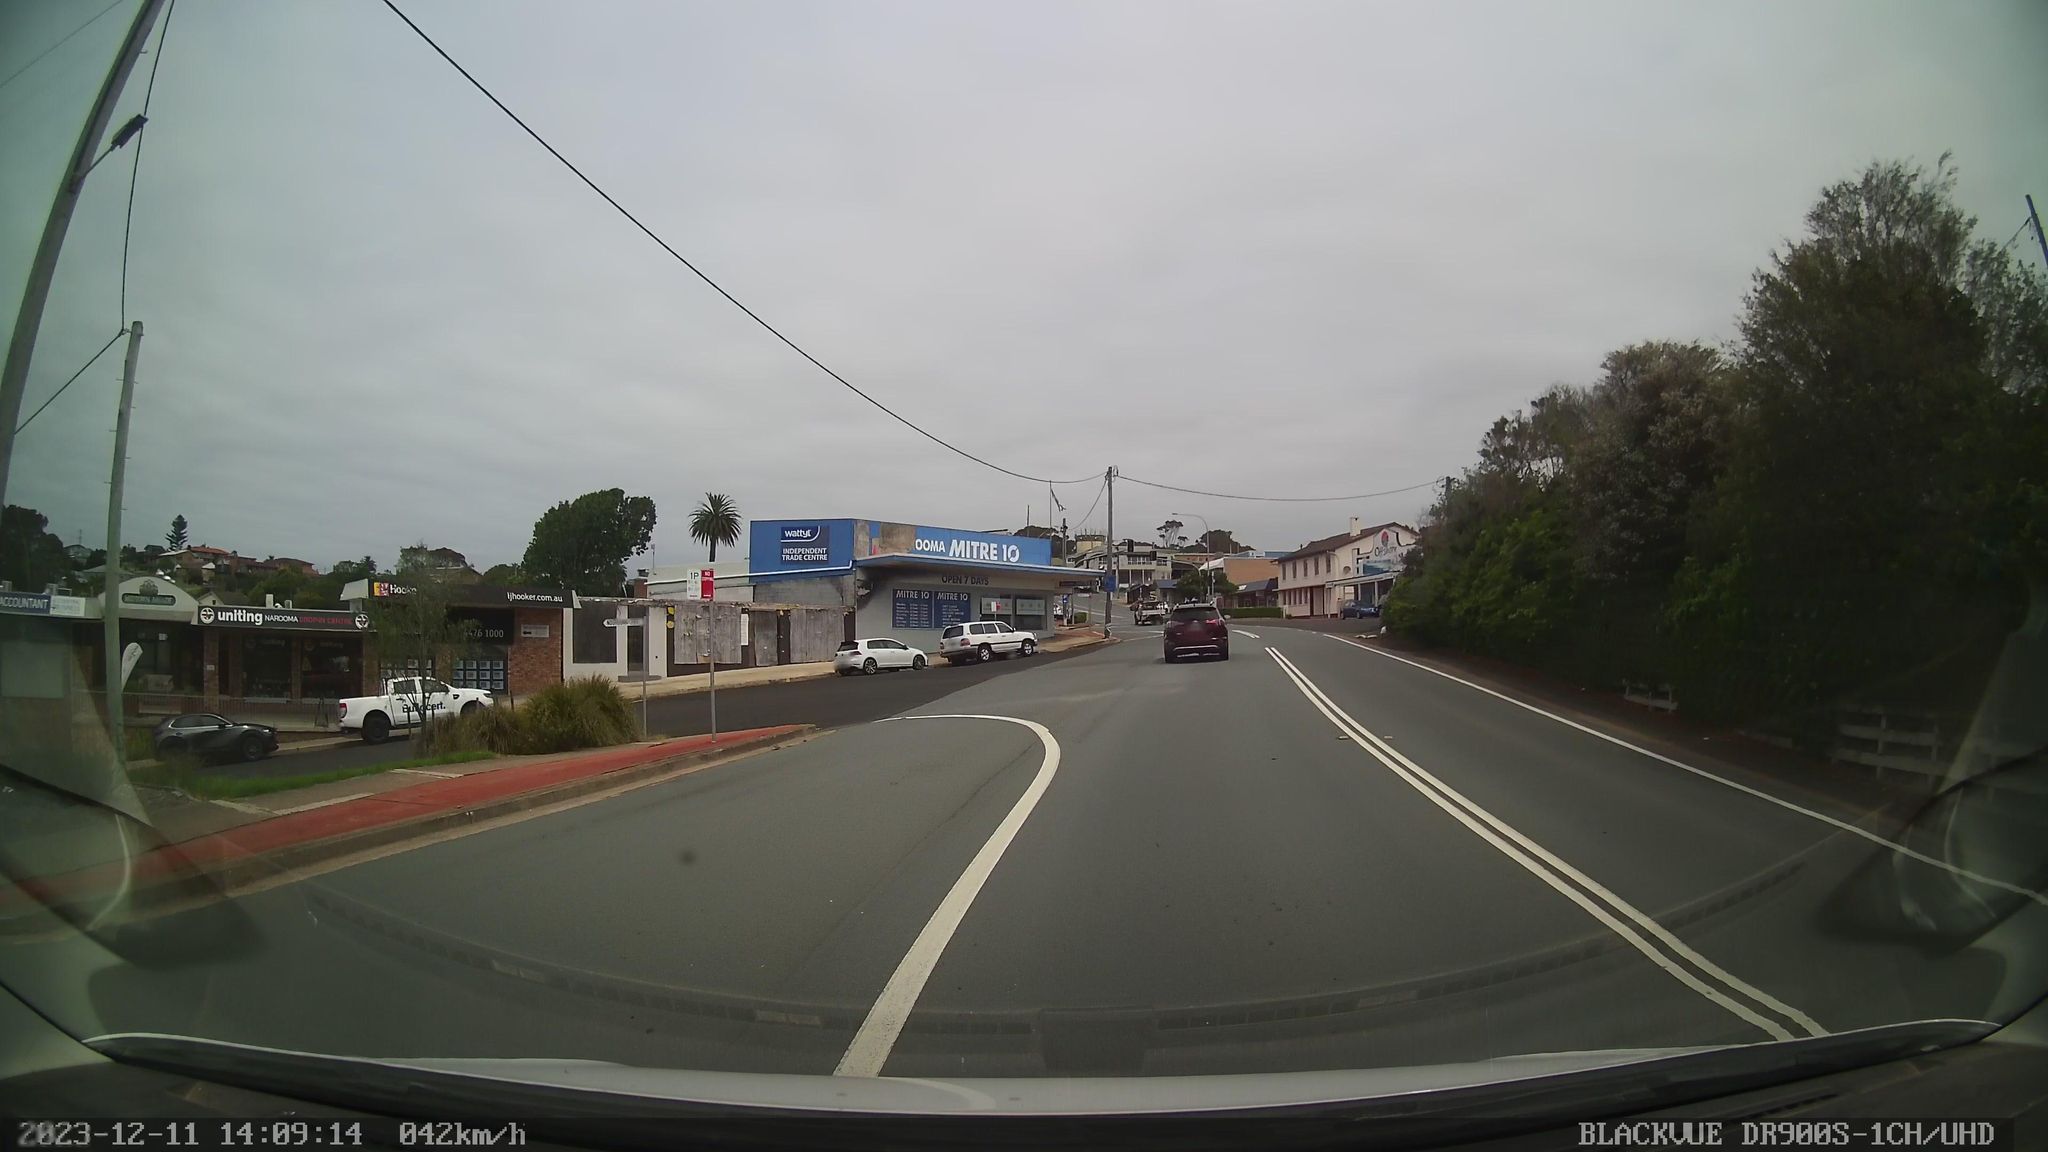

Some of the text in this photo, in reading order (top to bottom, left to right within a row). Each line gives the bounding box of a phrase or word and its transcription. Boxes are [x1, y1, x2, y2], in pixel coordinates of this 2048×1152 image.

[784, 528, 811, 538] wattyl
[783, 547, 827, 555] INDEPENDENT
[949, 539, 998, 561] MITRE
[1002, 544, 1020, 563] 10
[941, 575, 990, 586] OPEN 7 DAYS
[896, 590, 930, 600] MITRE 10
[937, 592, 968, 601] MITRE 10
[217, 609, 263, 626] uniting
[264, 614, 299, 623] NAROOMA
[485, 629, 504, 638] 1000
